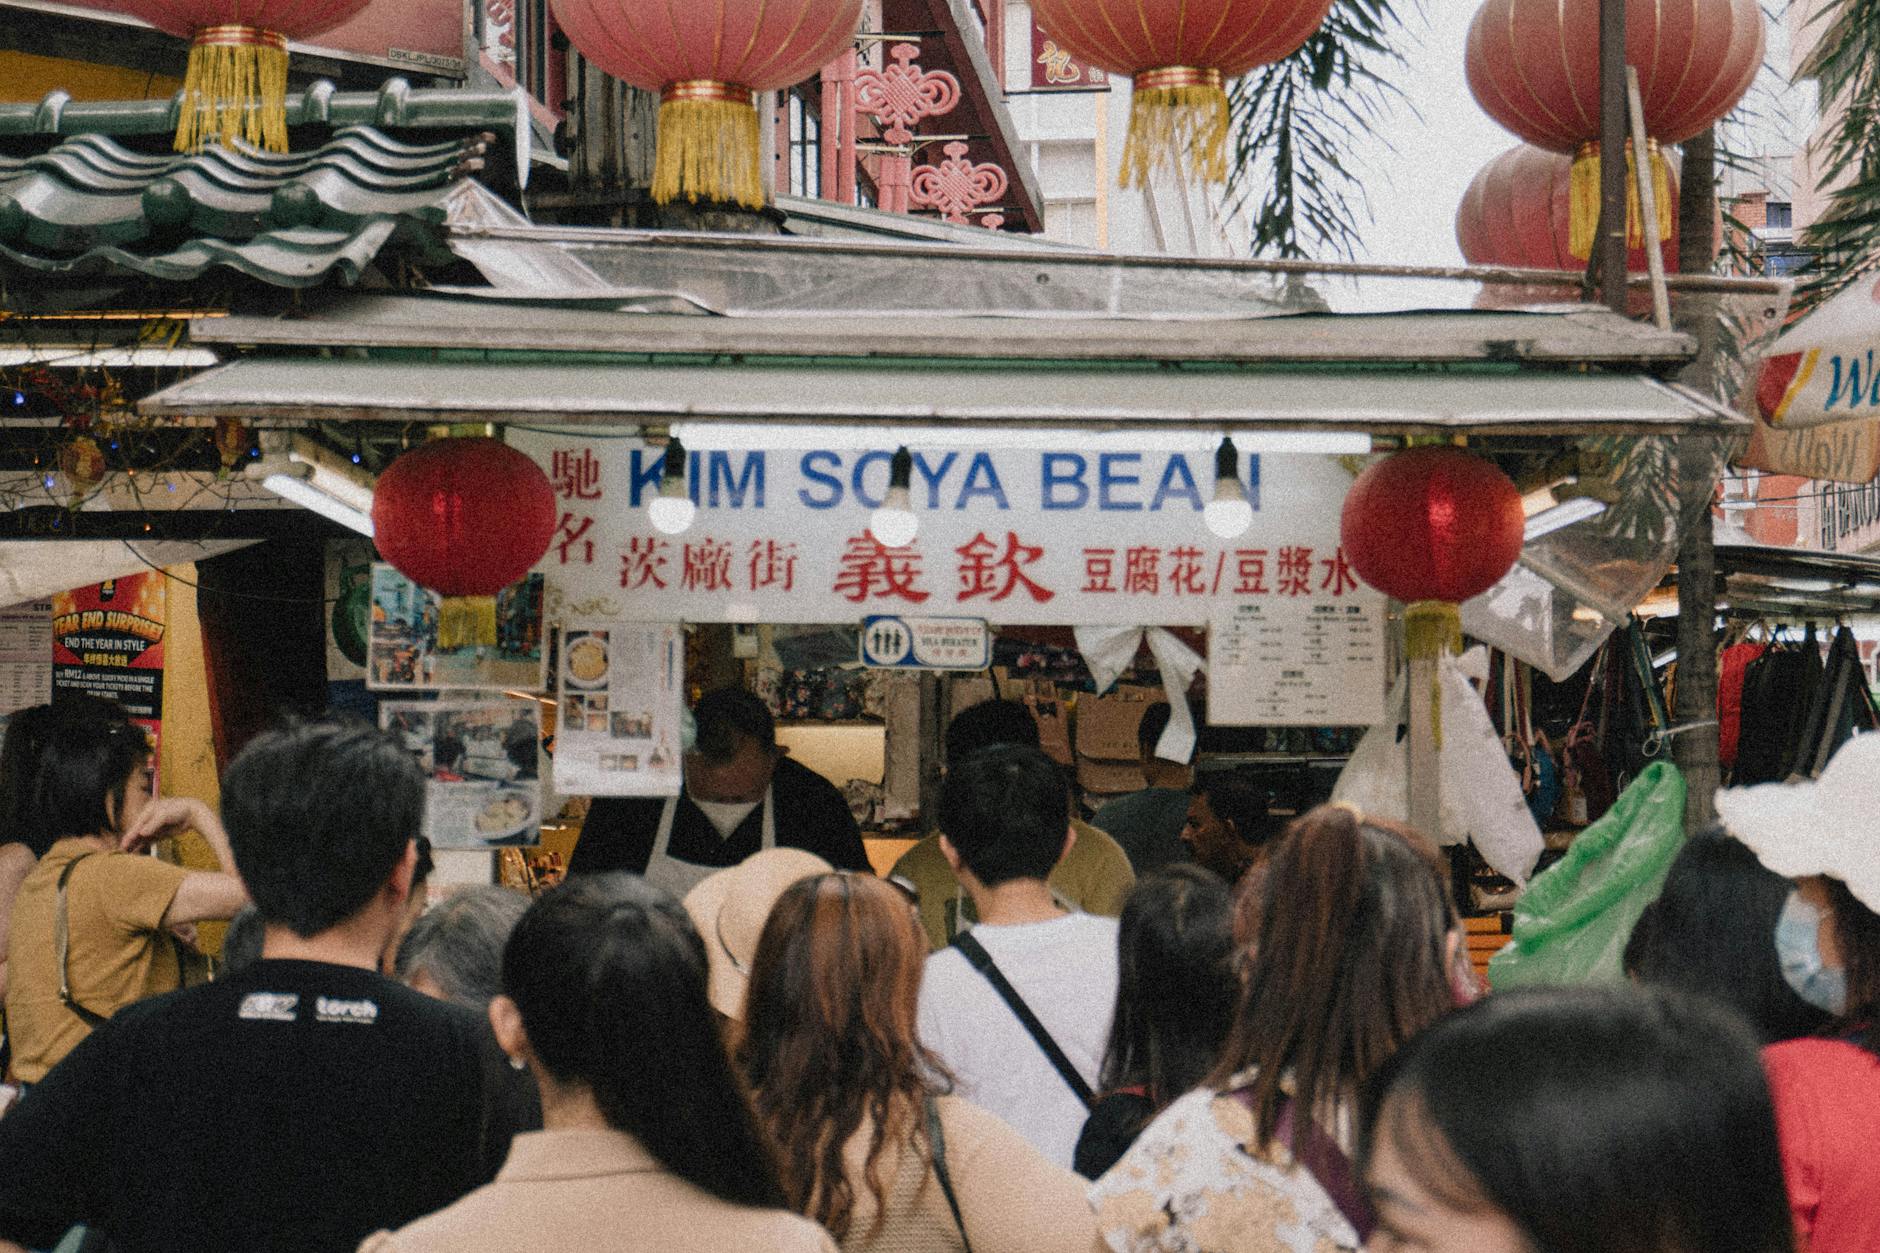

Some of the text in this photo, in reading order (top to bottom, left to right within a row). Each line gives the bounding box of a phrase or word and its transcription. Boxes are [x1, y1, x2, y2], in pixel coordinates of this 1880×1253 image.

[629, 449, 766, 509] KIM
[797, 450, 1011, 510] SOYA
[82, 611, 105, 631] END
[64, 637, 80, 648] END
[81, 638, 95, 649] THE
[96, 638, 113, 650] YEAR
[114, 640, 123, 650] IN
[123, 640, 145, 652] STYLE
[64, 668, 82, 679] RM12
